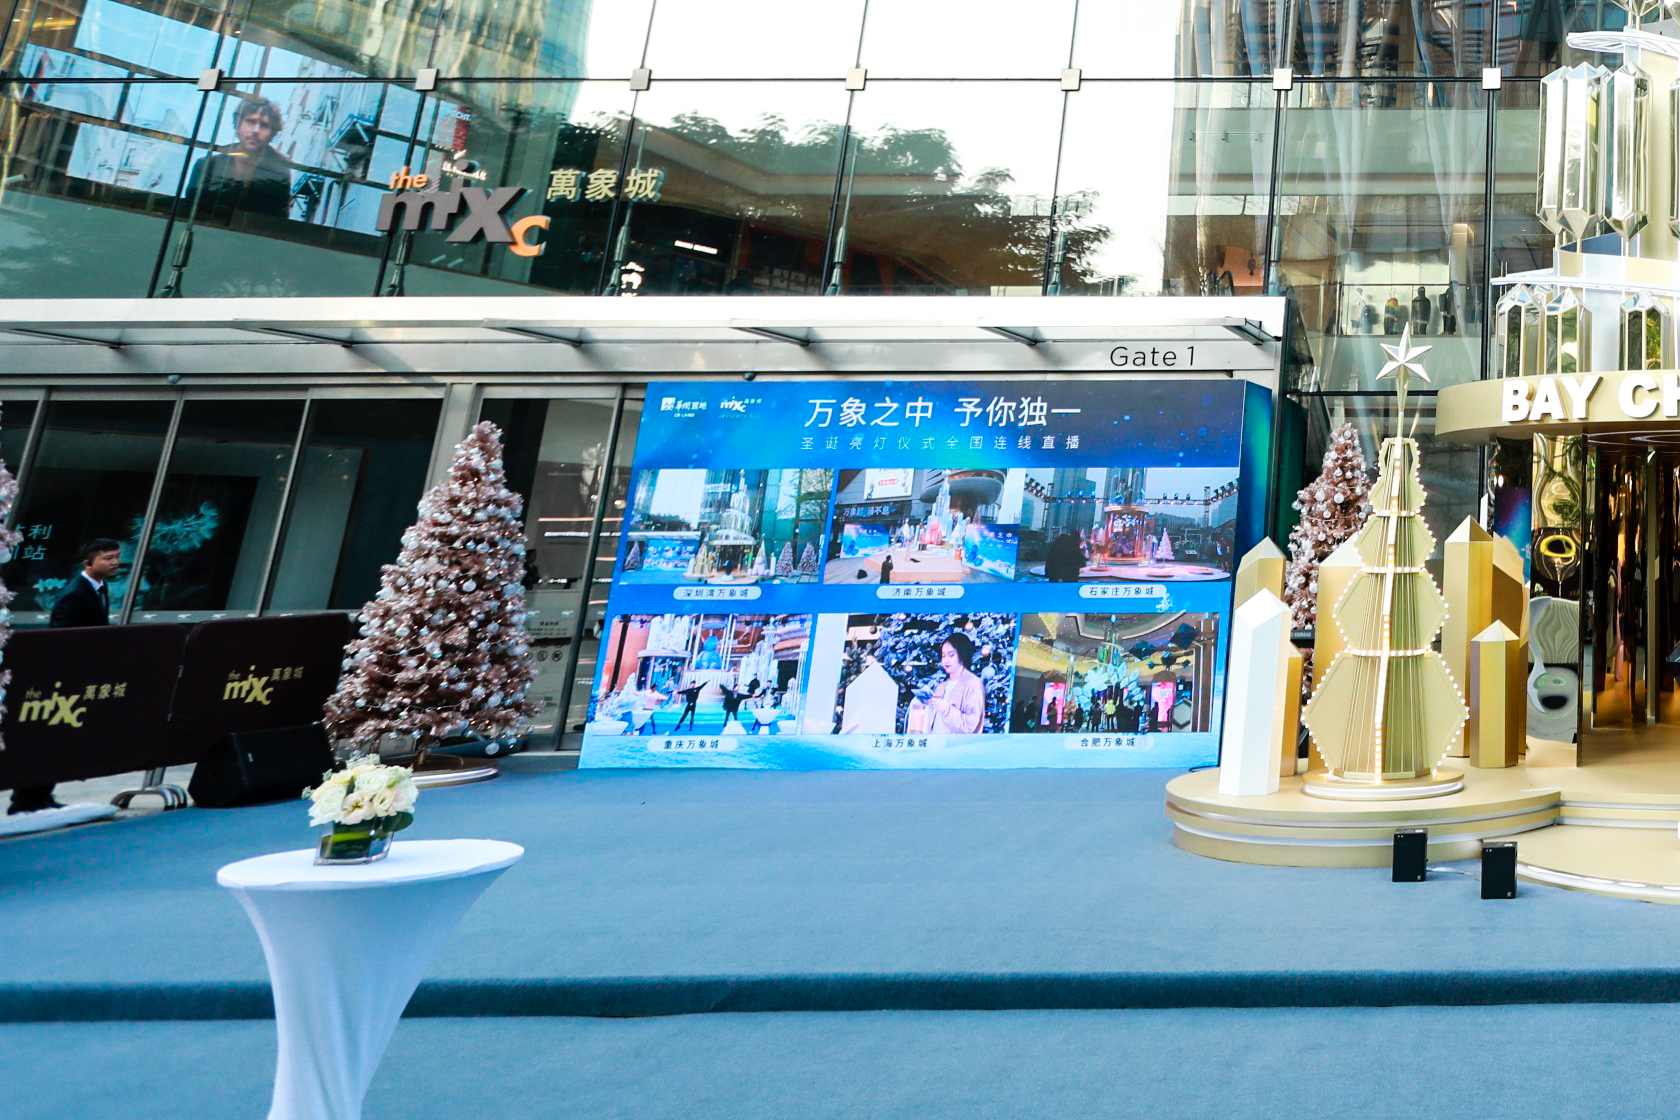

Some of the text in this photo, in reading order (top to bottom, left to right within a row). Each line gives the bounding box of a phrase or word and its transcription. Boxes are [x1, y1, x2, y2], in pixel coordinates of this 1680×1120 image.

[389, 165, 429, 190] the
[546, 167, 664, 202] 萬象城
[1110, 345, 1195, 367] Gate 1
[1500, 375, 1604, 423] BAY
[803, 396, 1082, 428] 万象之中 予你独一
[892, 587, 947, 597] 济南万象城
[1089, 586, 1155, 596] 石家庄万象城
[663, 739, 720, 750] 重庆万象城
[1080, 737, 1136, 747] 合肥万象城
